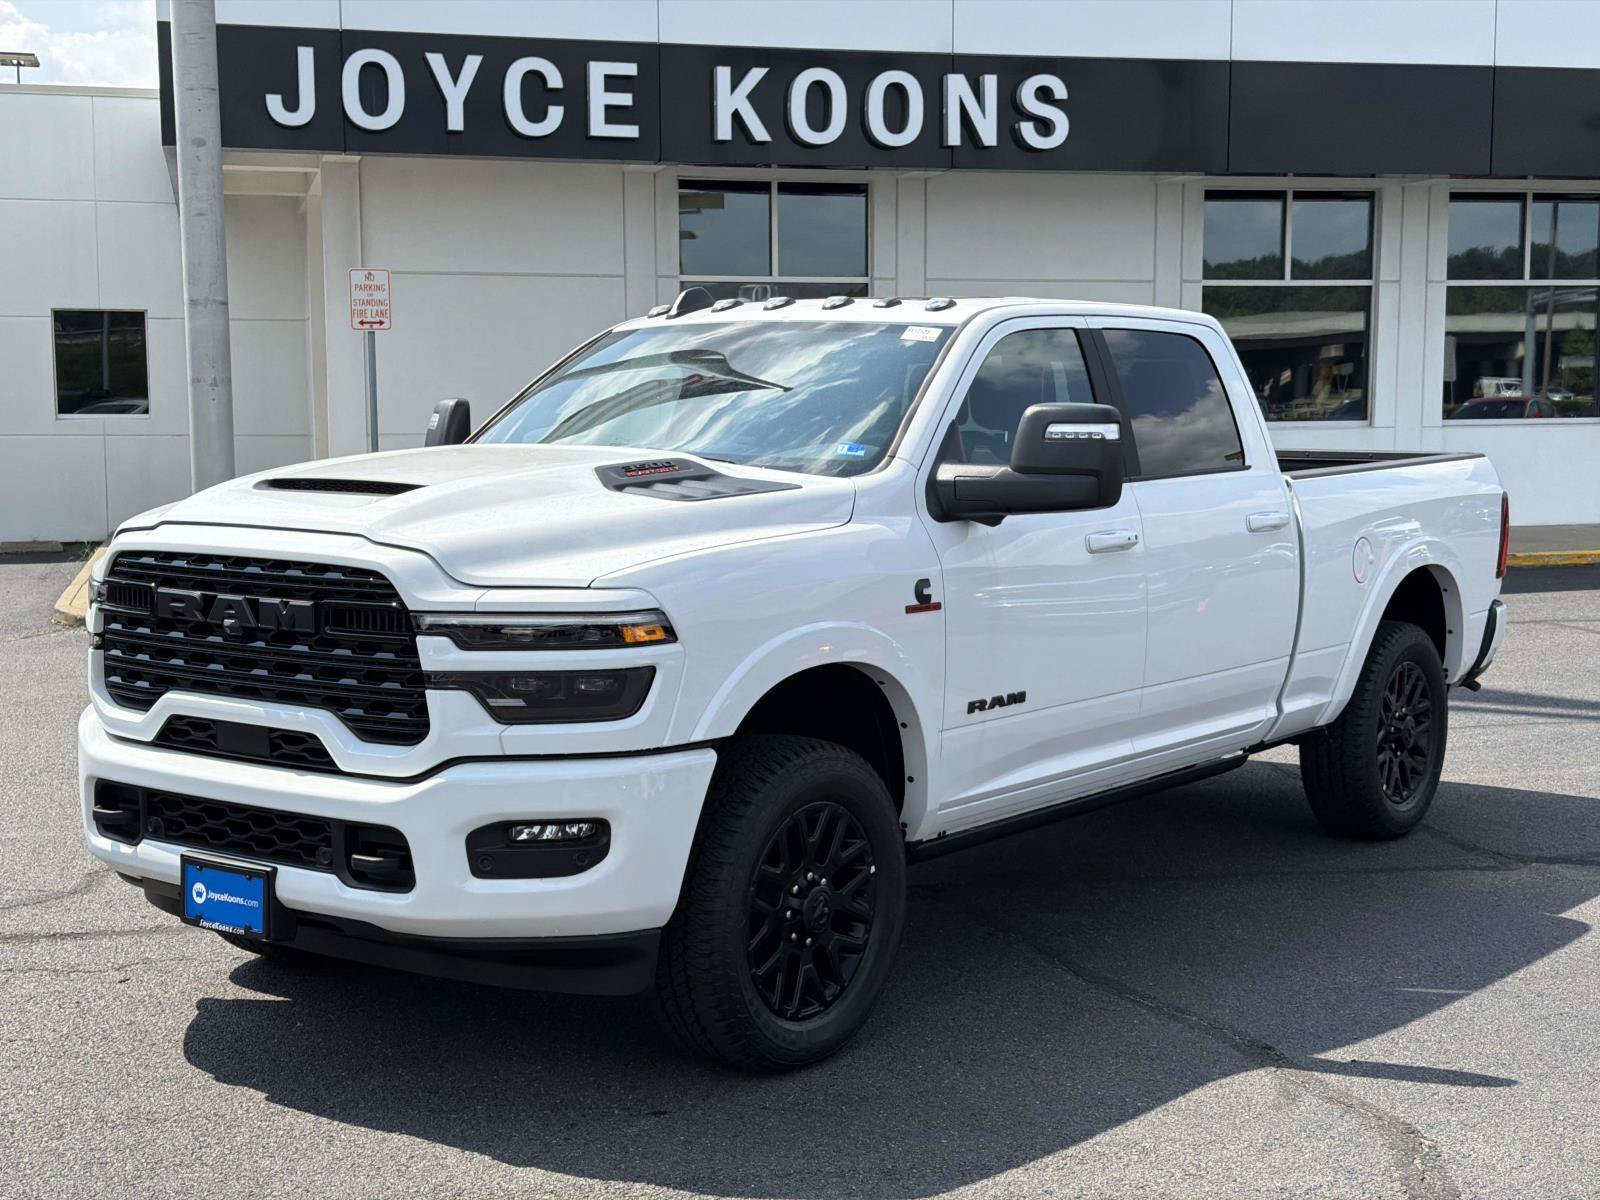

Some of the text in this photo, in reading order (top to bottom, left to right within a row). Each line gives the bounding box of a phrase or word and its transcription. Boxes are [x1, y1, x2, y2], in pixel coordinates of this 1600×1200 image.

[265, 46, 1070, 150] JOYCE KOONS
[365, 272, 375, 281] NO
[354, 284, 385, 292] PARKING
[353, 299, 388, 307] STANDING
[352, 309, 388, 318] FIRE LANE
[157, 587, 314, 633] RAM
[967, 691, 1026, 714] RAM
[207, 890, 259, 907] JoyceKoons.com
[199, 919, 245, 935] JoyceKoons.com
